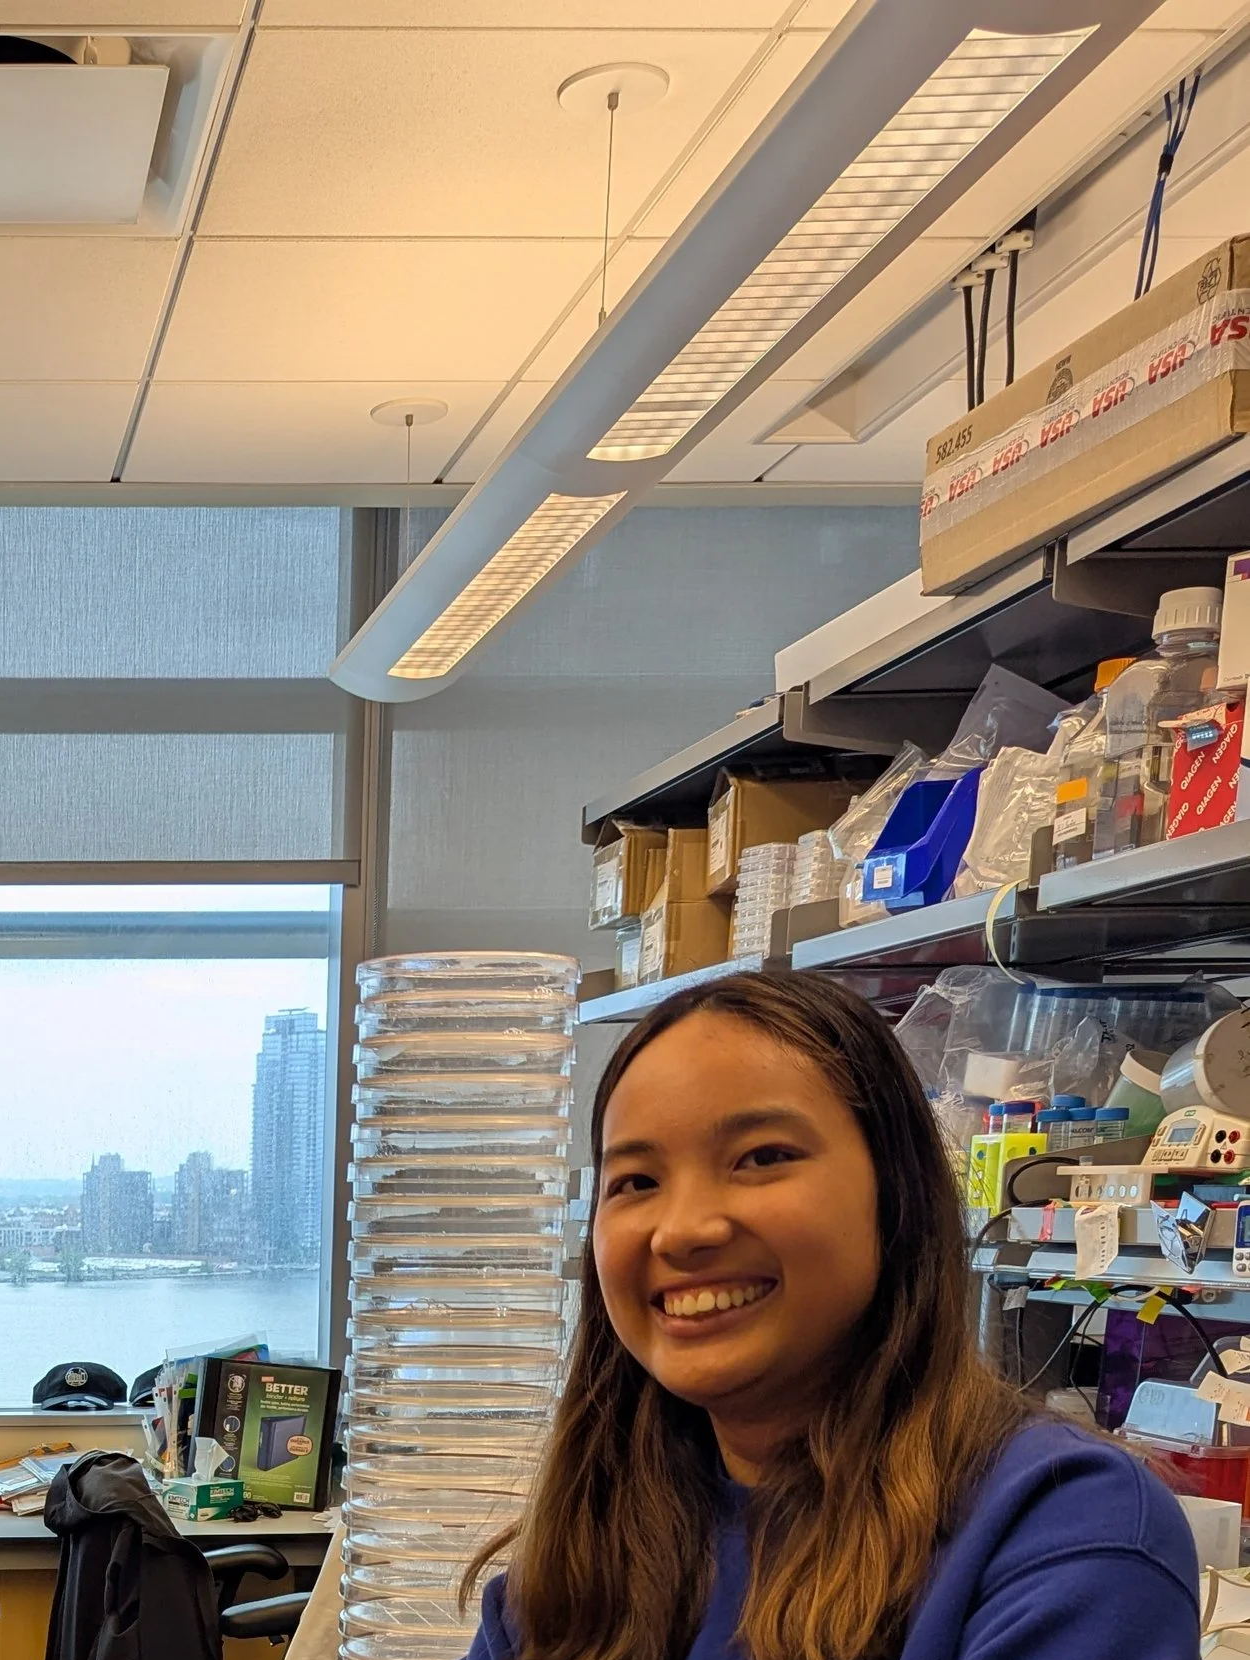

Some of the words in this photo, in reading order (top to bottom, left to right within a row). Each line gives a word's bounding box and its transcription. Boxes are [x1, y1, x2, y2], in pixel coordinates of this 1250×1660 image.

[935, 424, 973, 465] 582.455
[1211, 723, 1238, 765] QIAGEN
[1180, 751, 1205, 791] QIAGEN
[1196, 776, 1222, 816] QIAGEN
[265, 1382, 309, 1396] BETTER
